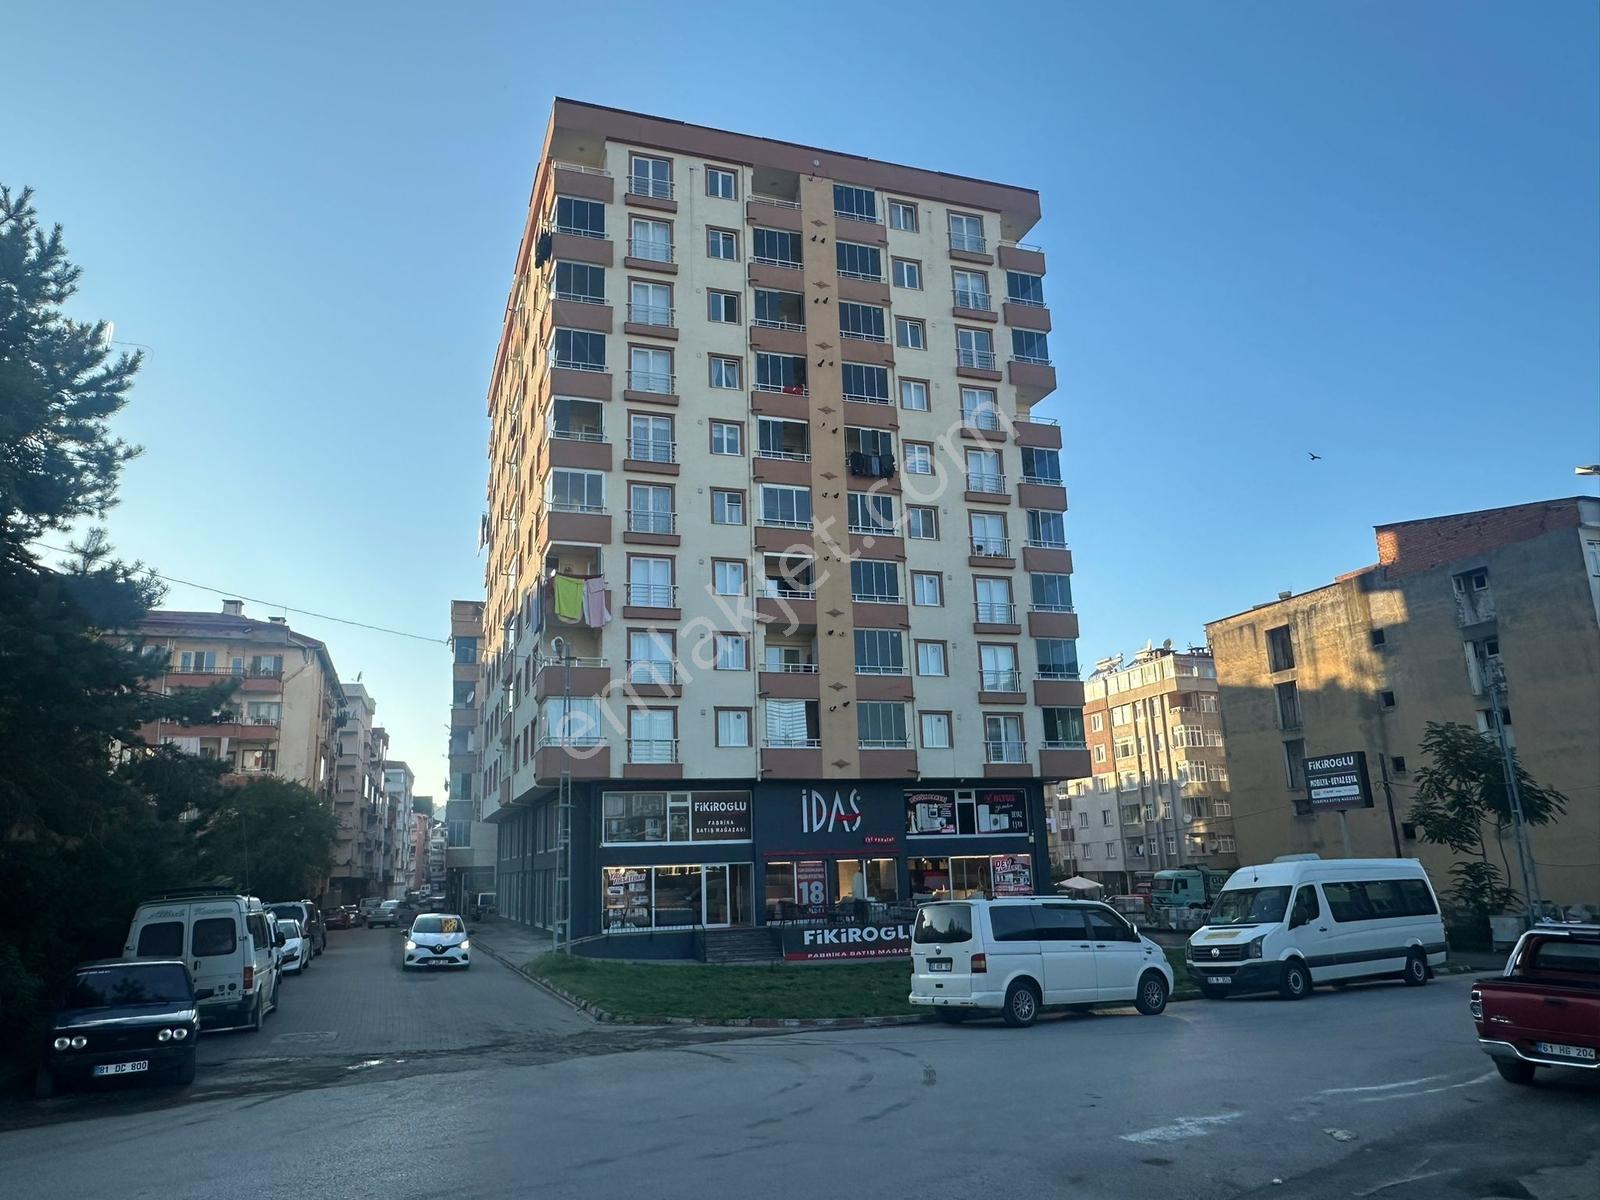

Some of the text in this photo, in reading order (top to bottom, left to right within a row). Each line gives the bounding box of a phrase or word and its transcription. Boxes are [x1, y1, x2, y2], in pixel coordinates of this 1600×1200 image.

[799, 881, 824, 905] 18
[1542, 1044, 1554, 1053] 61
[1576, 1048, 1594, 1058] 204
